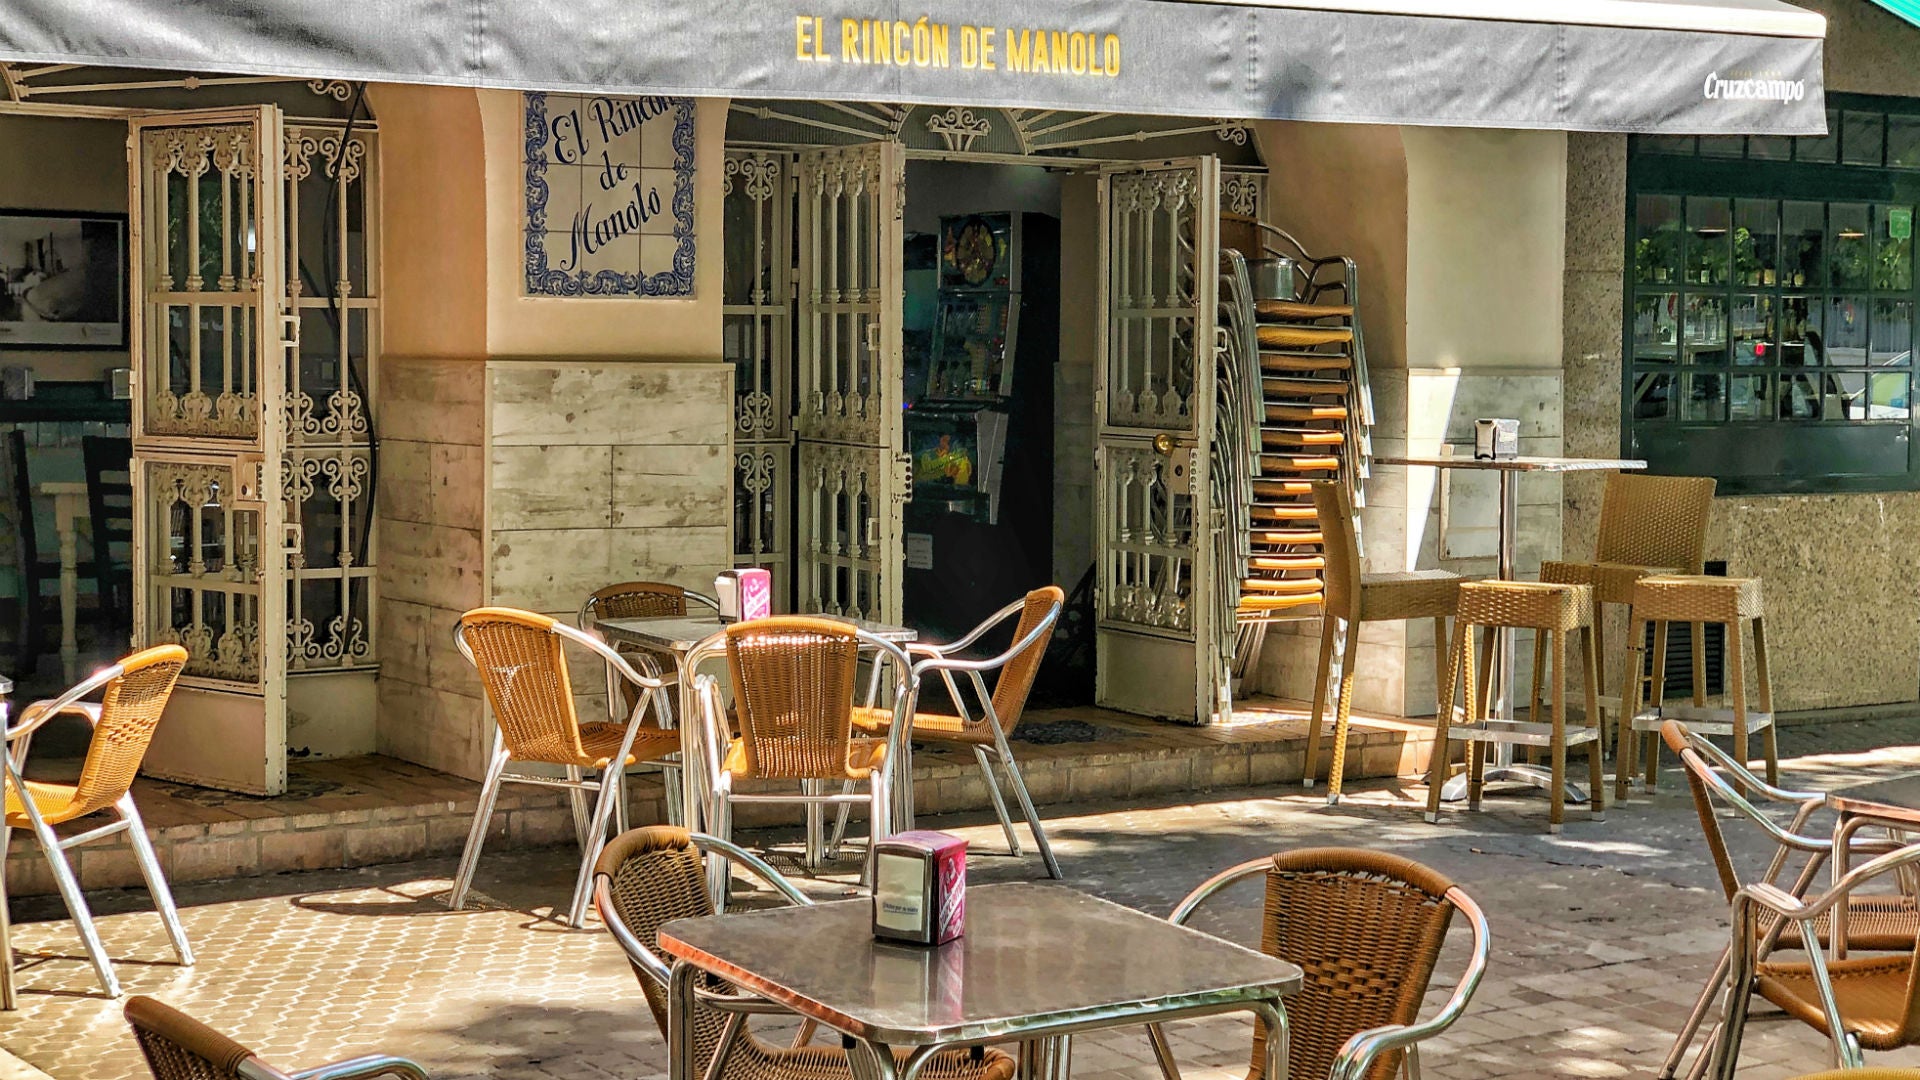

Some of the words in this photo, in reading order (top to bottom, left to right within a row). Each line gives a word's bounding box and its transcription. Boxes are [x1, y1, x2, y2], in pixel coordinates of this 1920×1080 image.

[796, 15, 831, 62] EL
[841, 16, 949, 68] RINCÓN
[960, 25, 996, 70] DE
[1006, 29, 1120, 77] MANOLO
[1703, 70, 1805, 105] Cruzcampo
[551, 109, 590, 164] El
[599, 150, 628, 191] de
[559, 182, 661, 272] Manolo
